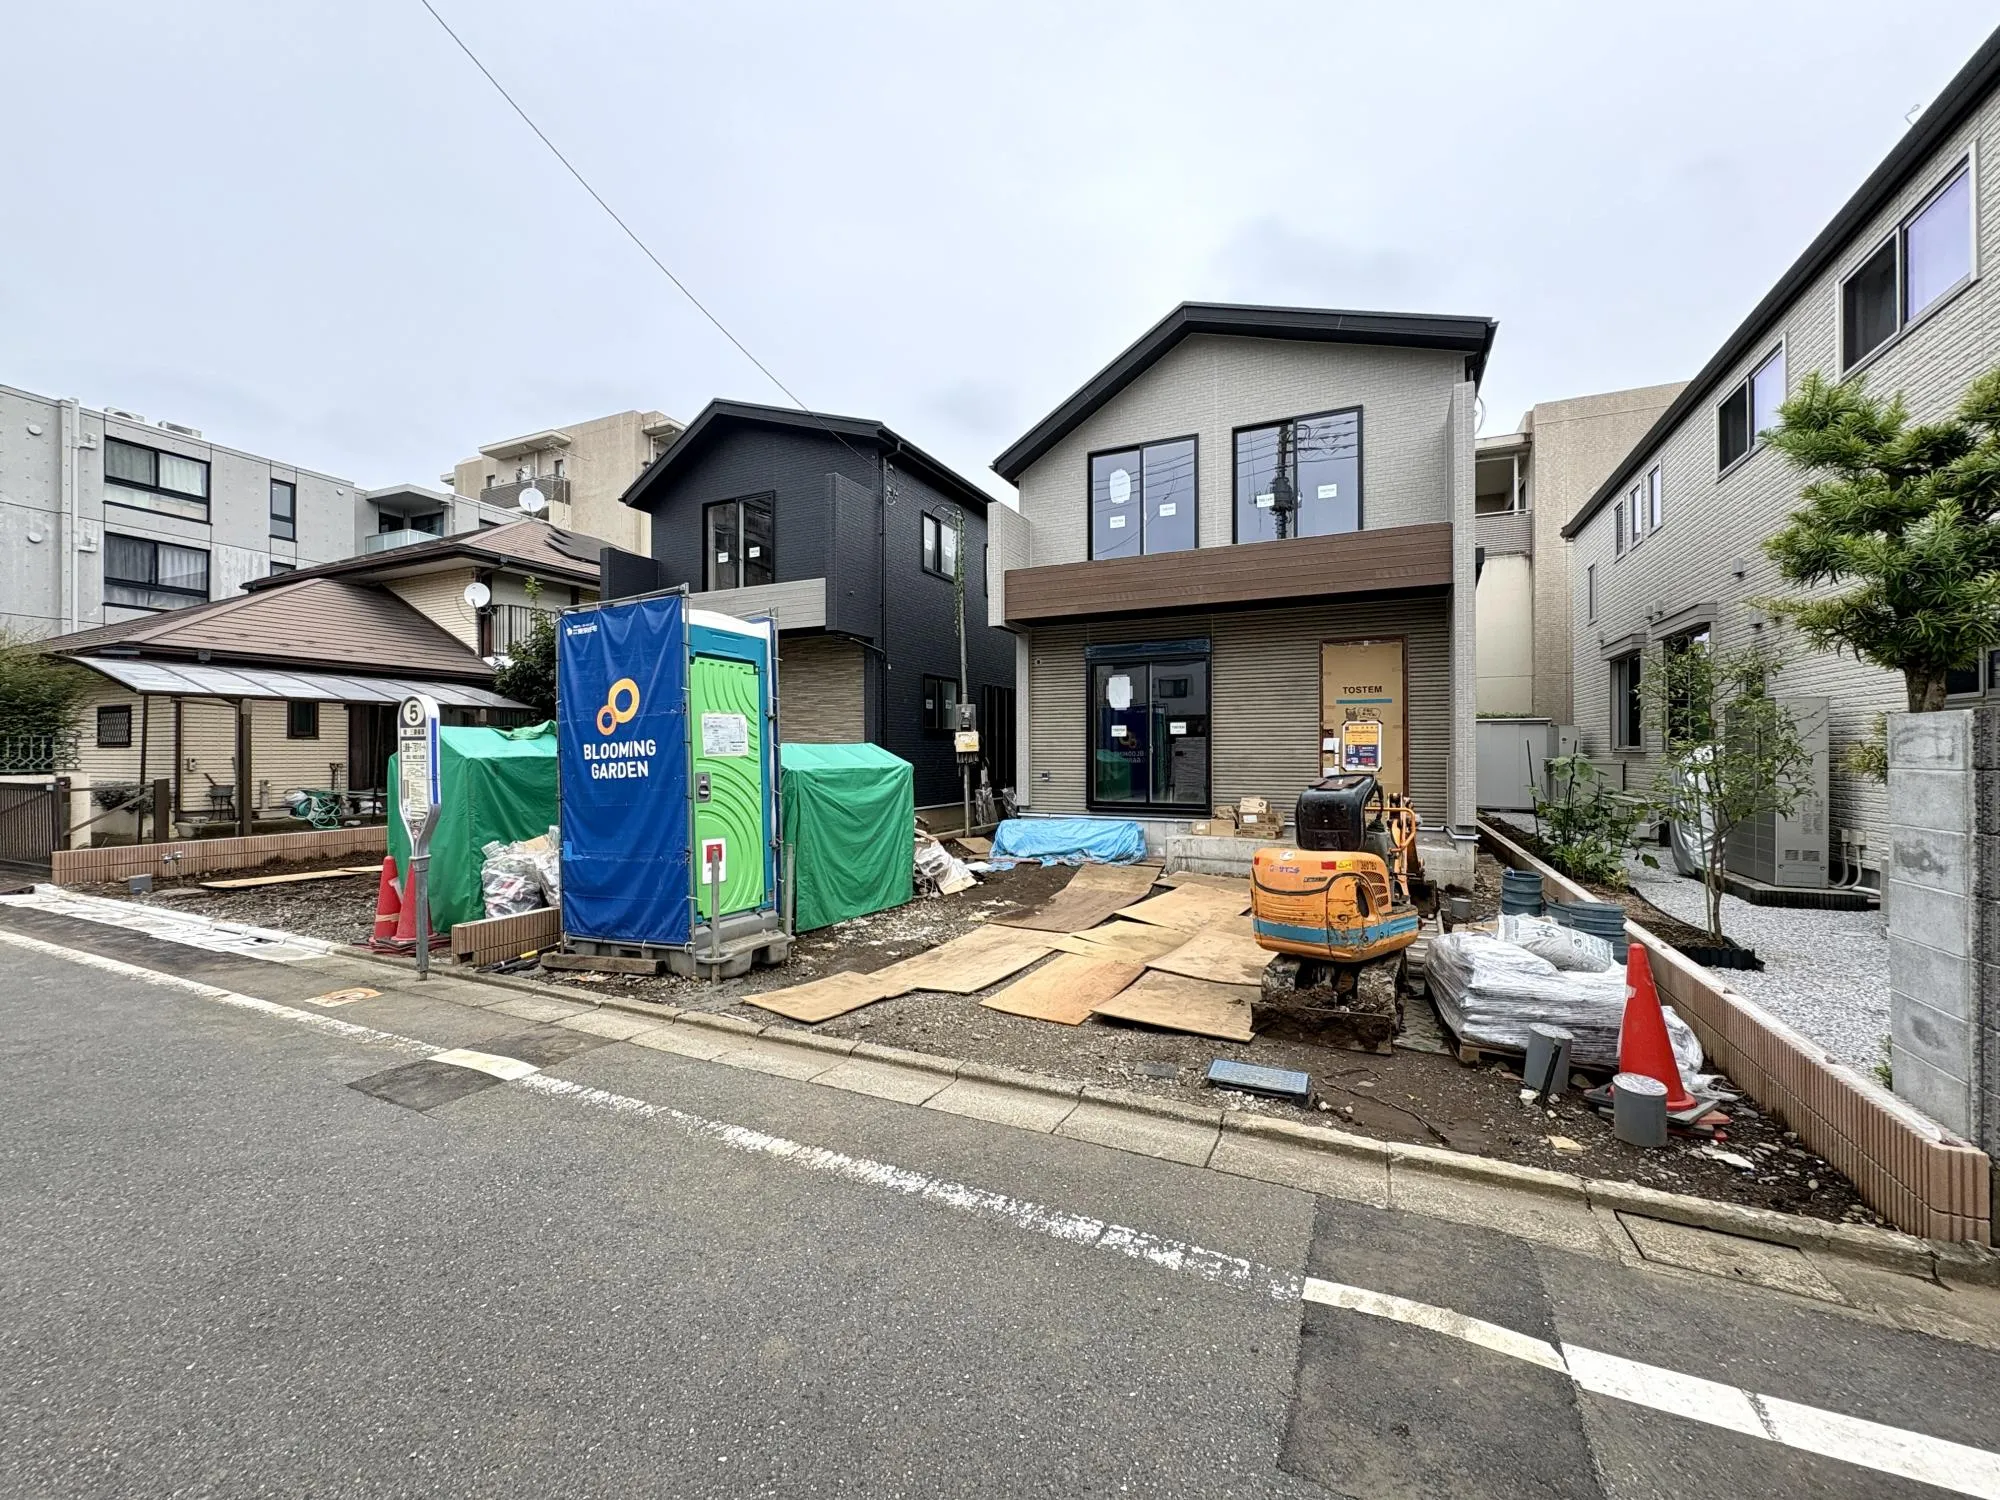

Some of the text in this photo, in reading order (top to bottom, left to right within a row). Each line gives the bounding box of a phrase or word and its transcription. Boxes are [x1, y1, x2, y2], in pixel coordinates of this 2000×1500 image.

[1343, 685, 1382, 694] TOSTEM
[410, 704, 419, 722] 5
[583, 739, 656, 760] BLOOMING
[591, 760, 649, 779] GARDEN
